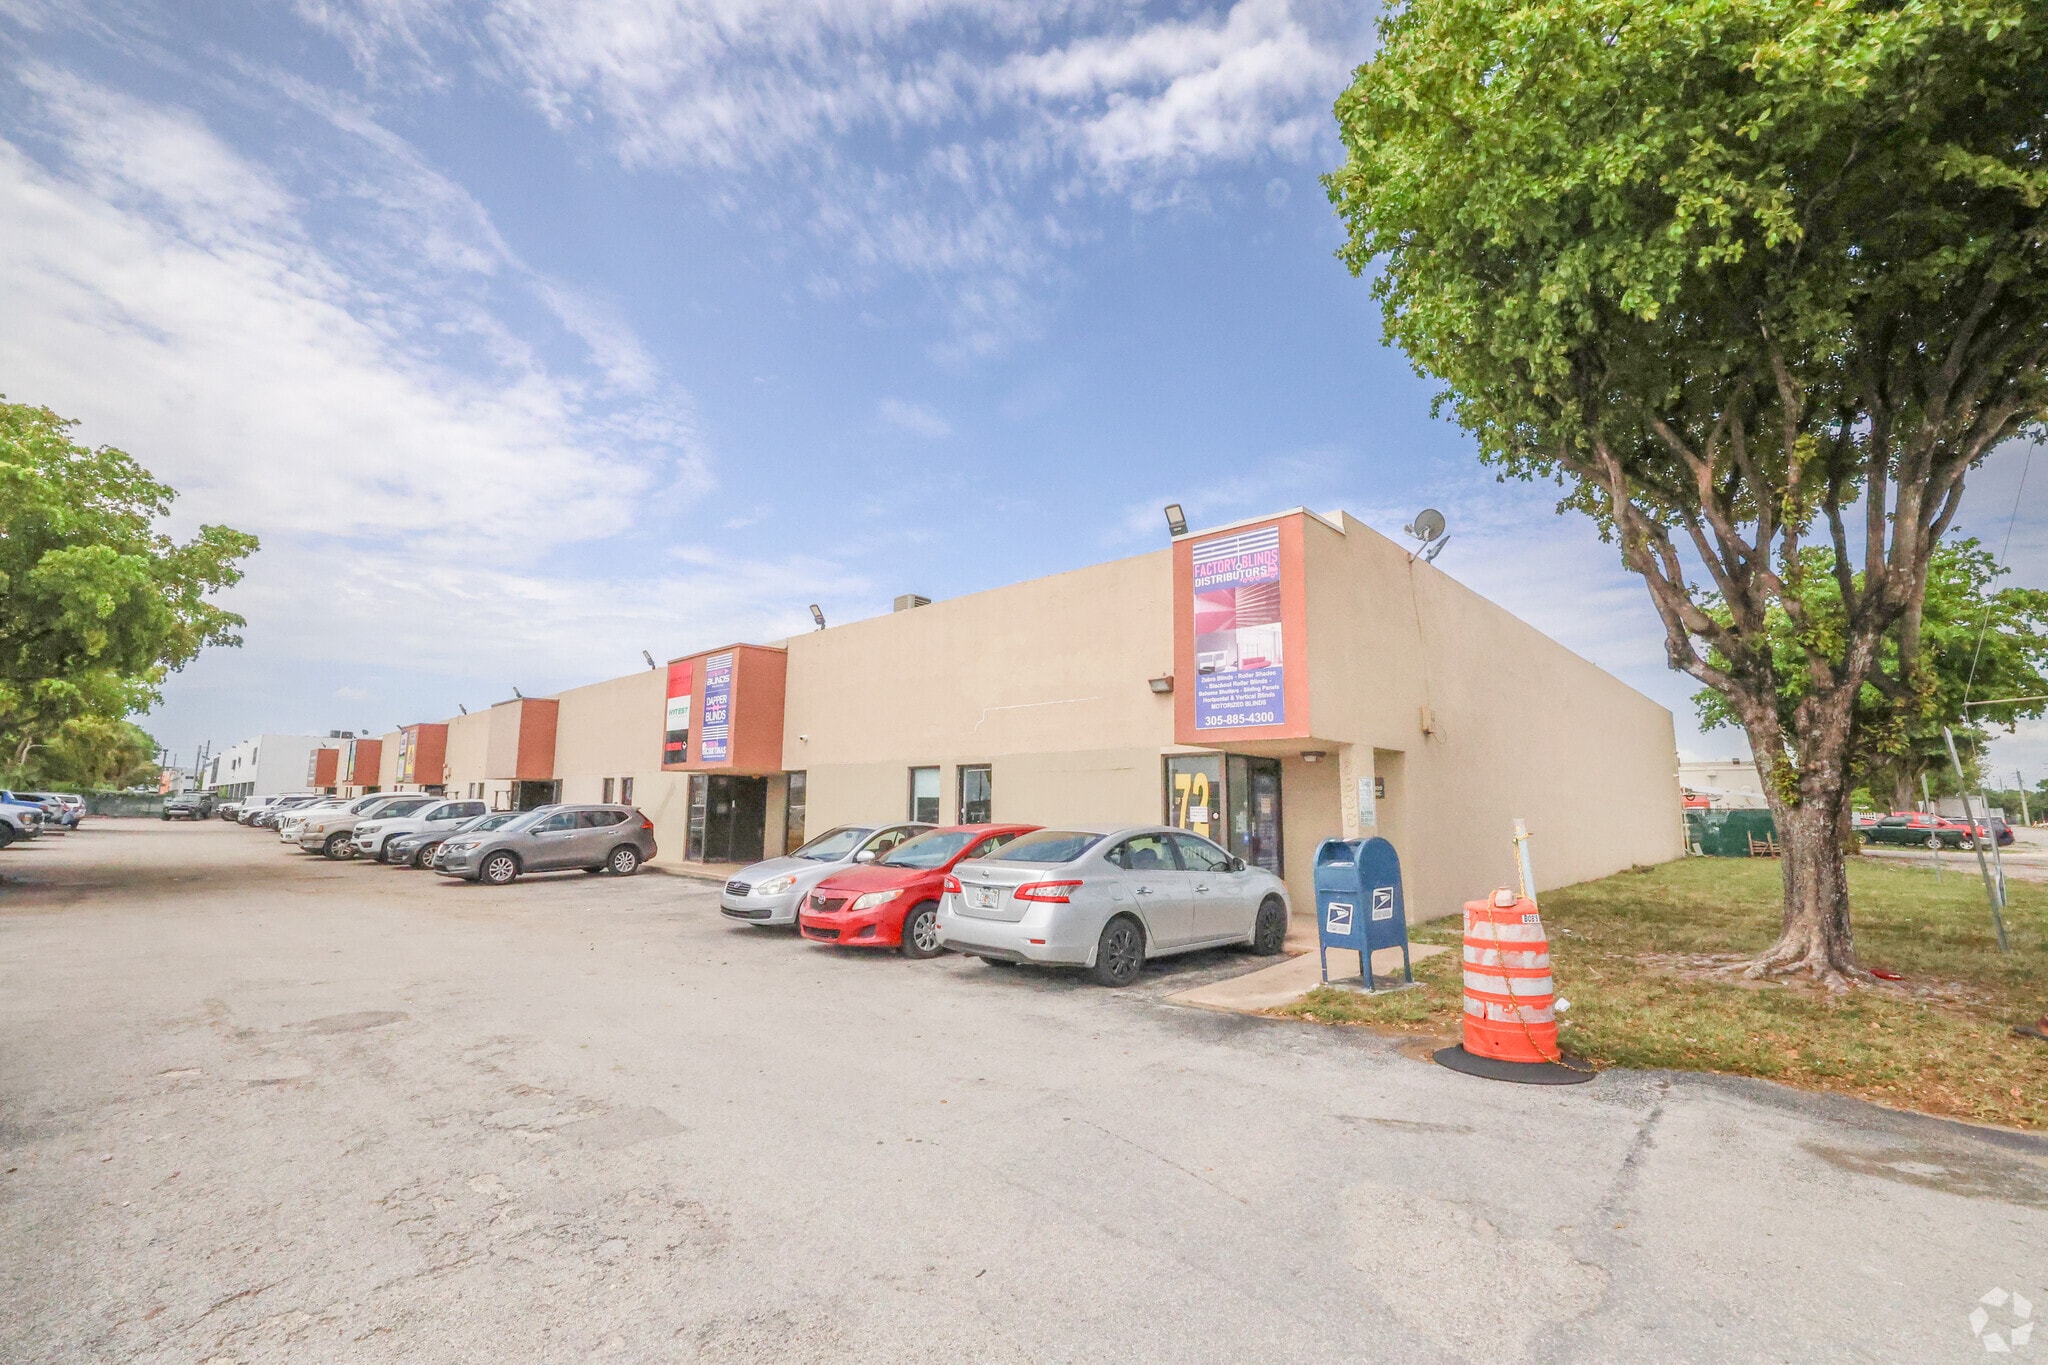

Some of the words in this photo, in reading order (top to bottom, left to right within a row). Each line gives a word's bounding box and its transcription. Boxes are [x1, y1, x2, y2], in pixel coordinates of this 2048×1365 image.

[1194, 557, 1237, 578] FACTORY
[1241, 549, 1278, 569] BLINDS
[1195, 565, 1268, 587] DISTRIBUTORS
[706, 694, 727, 706] DAPPER
[1211, 702, 1244, 710] MOTORIZED
[706, 710, 726, 722] BLINDS
[1205, 711, 1274, 726] 305-885-4300
[1175, 772, 1210, 839] 72
